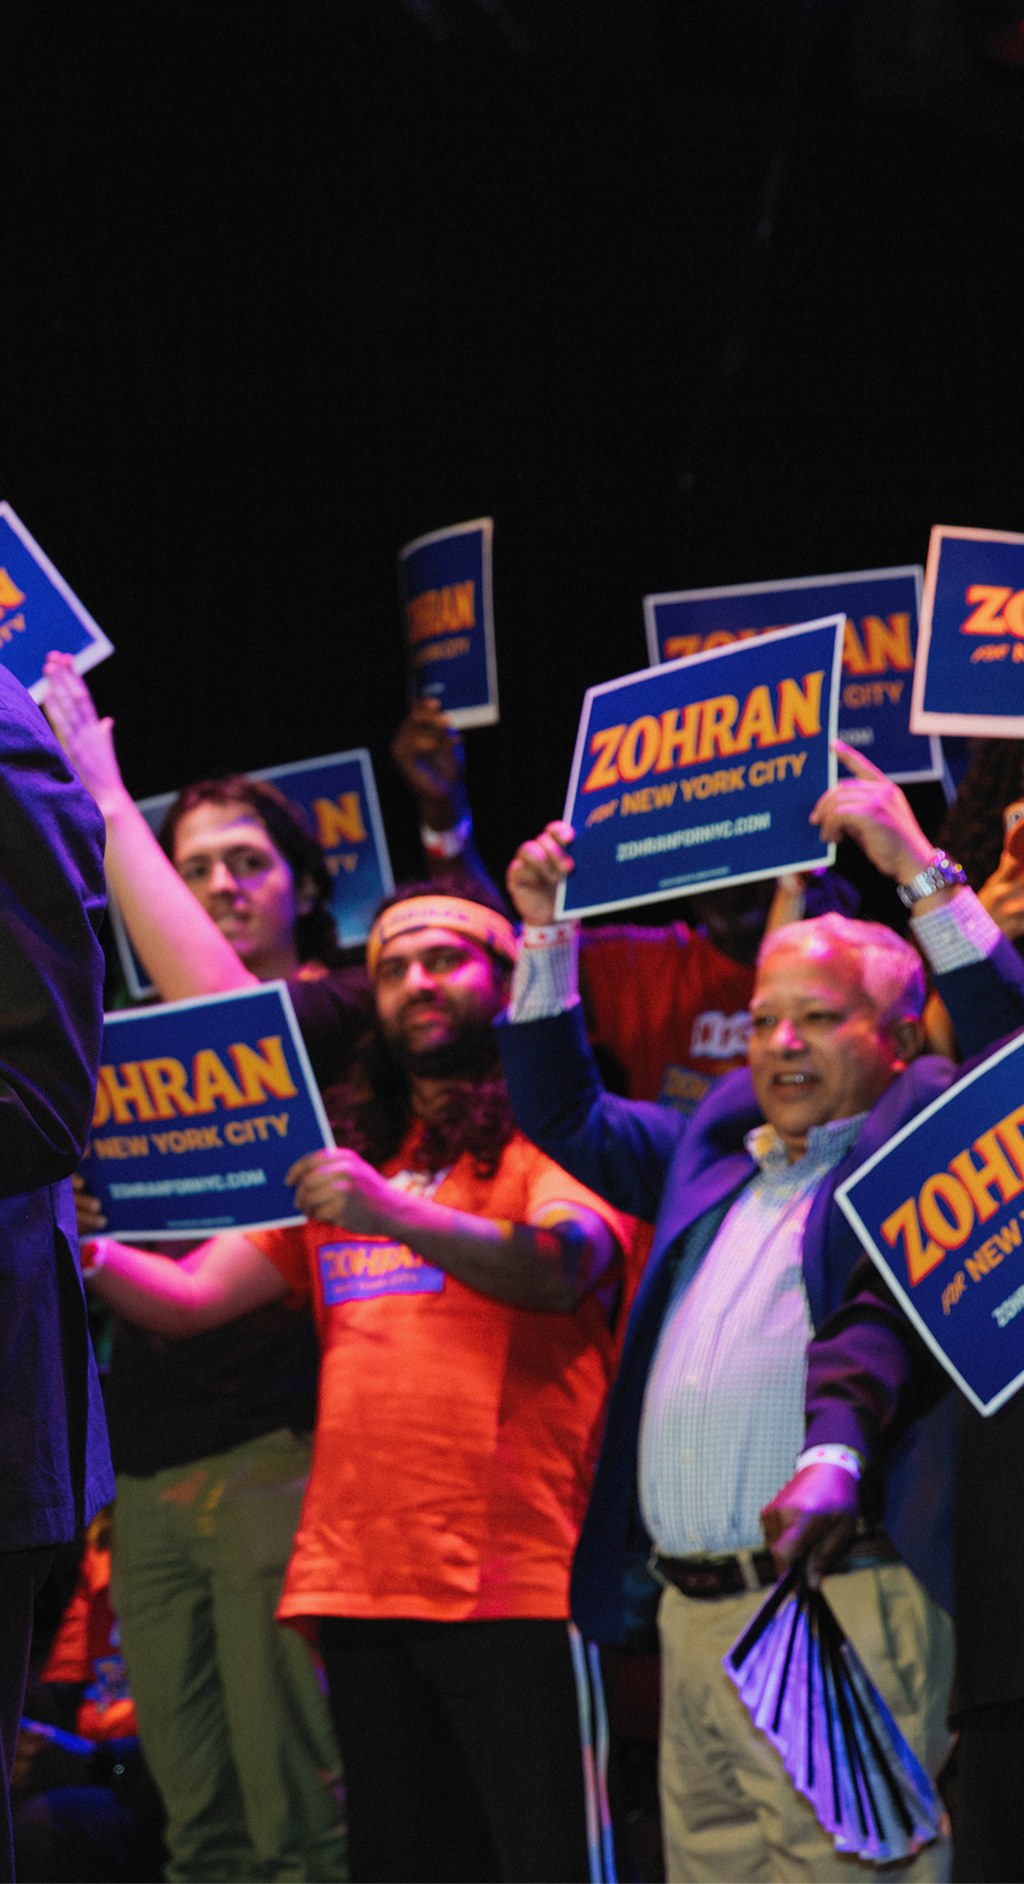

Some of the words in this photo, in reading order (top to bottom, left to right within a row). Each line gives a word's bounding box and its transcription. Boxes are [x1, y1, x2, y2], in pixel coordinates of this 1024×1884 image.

[582, 669, 826, 794] ZOHRAN
[620, 782, 678, 818] NEW
[679, 766, 747, 803] YORK
[748, 750, 808, 788] CITY
[151, 1125, 224, 1155] YORK
[224, 1112, 289, 1146] CITY
[963, 1218, 1023, 1283] NEW
